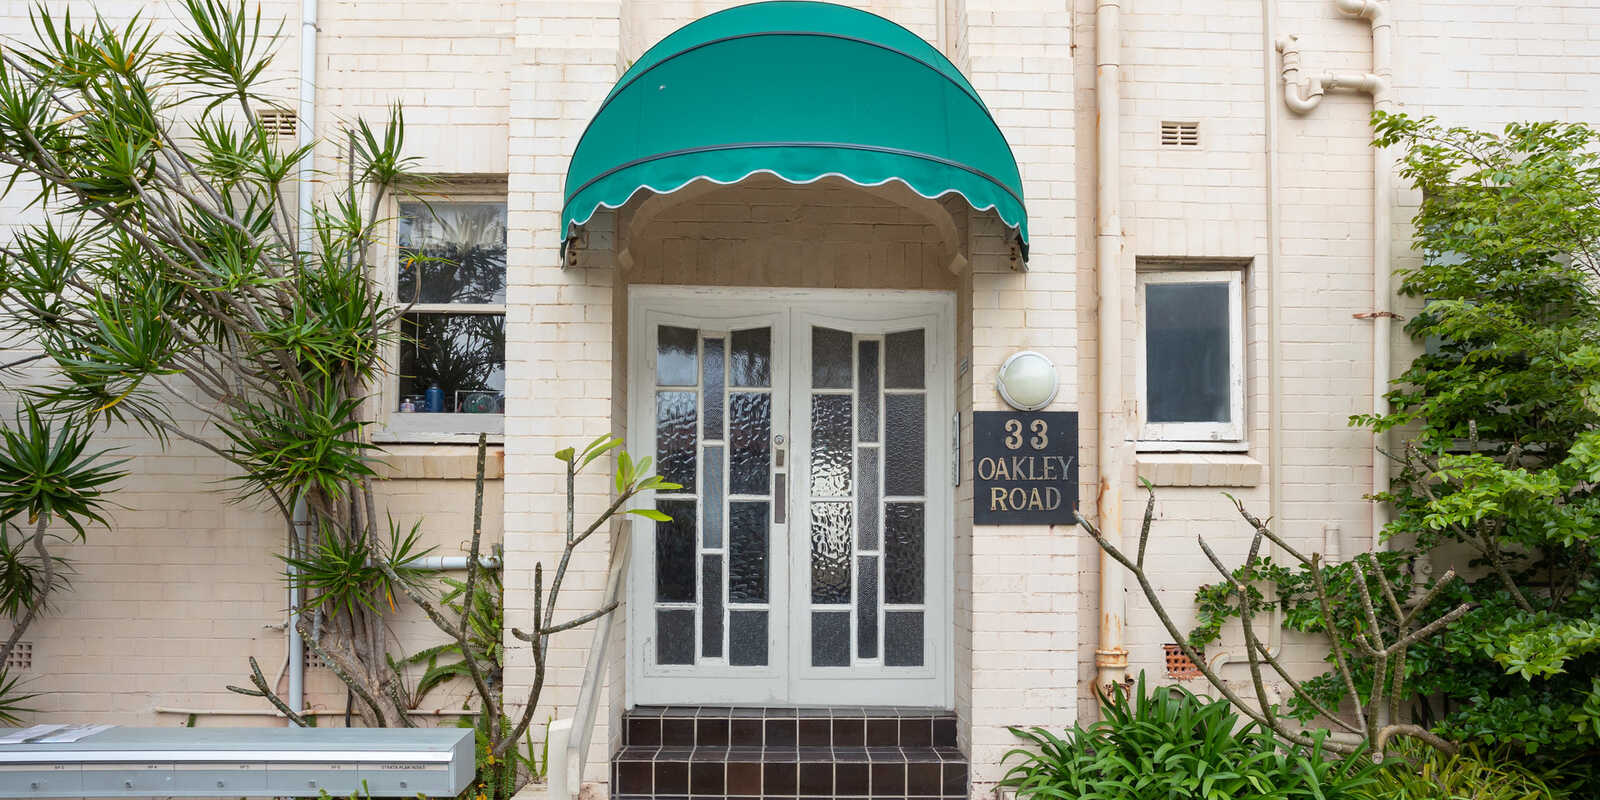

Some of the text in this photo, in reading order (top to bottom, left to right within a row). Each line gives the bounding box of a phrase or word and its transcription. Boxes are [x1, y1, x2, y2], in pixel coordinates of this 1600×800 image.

[1005, 419, 1048, 449] 33
[978, 456, 1074, 480] OAKLEY
[990, 486, 1061, 510] ROAD
